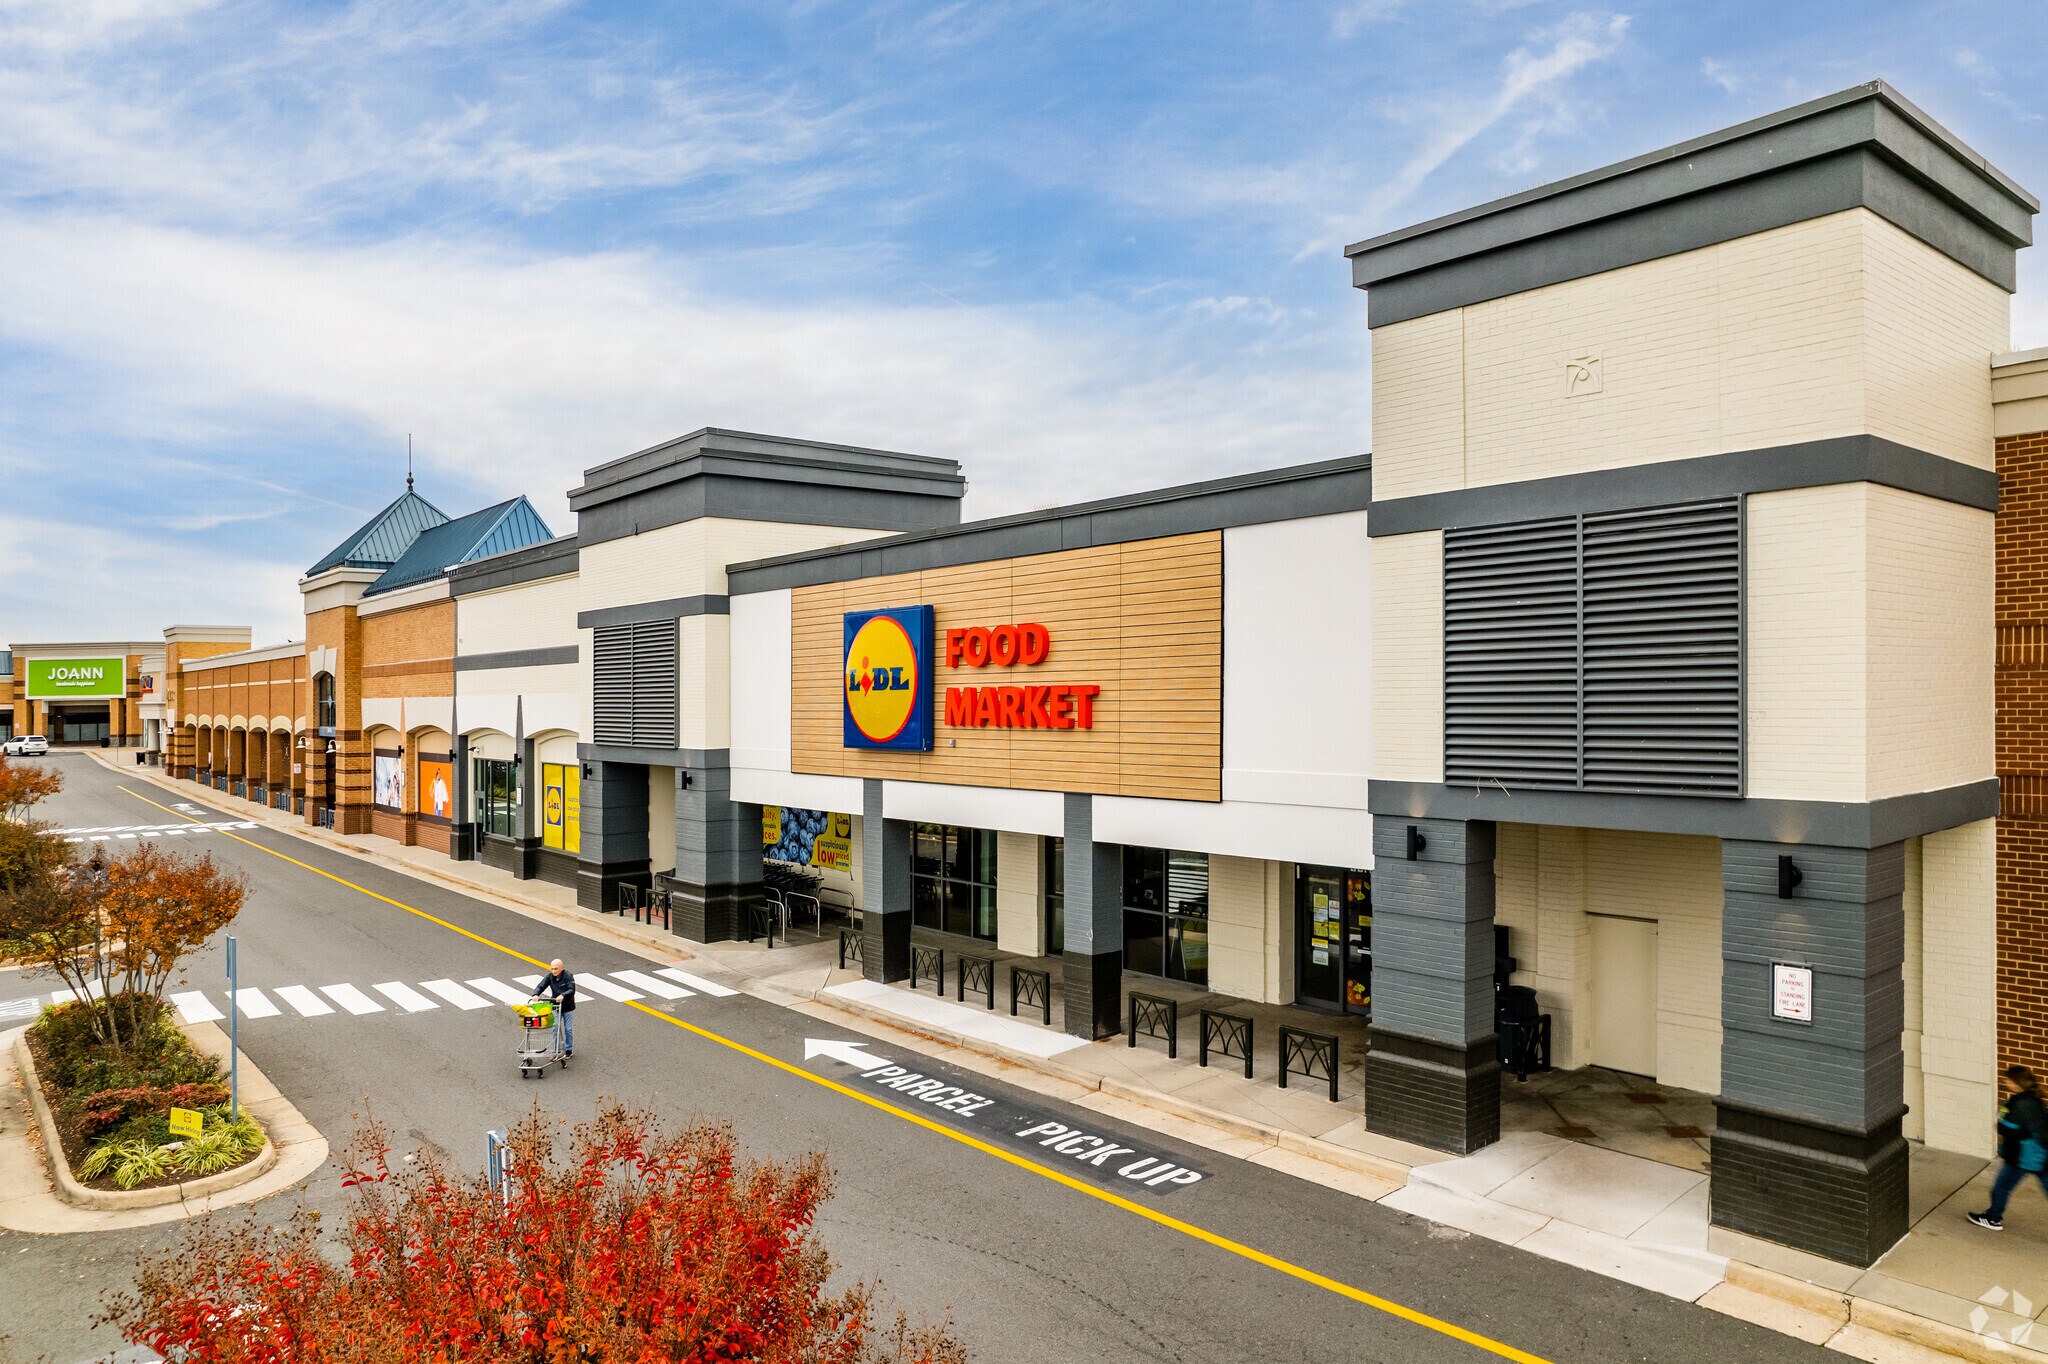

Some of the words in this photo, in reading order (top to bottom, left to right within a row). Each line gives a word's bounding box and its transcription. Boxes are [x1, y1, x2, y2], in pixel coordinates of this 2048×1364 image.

[946, 623, 1050, 669] FOOD
[48, 667, 104, 680] JOANN
[944, 685, 1100, 729] MARKET
[818, 840, 834, 864] low
[836, 850, 849, 861] priced
[821, 839, 849, 853] suspiciously
[1780, 991, 1806, 1000] STANDING
[1792, 1001, 1806, 1009] LANE
[185, 1126, 200, 1136] Hiring
[861, 1064, 995, 1118] PARCEL
[1015, 1121, 1136, 1166] PICK
[1117, 1157, 1203, 1187] UP
